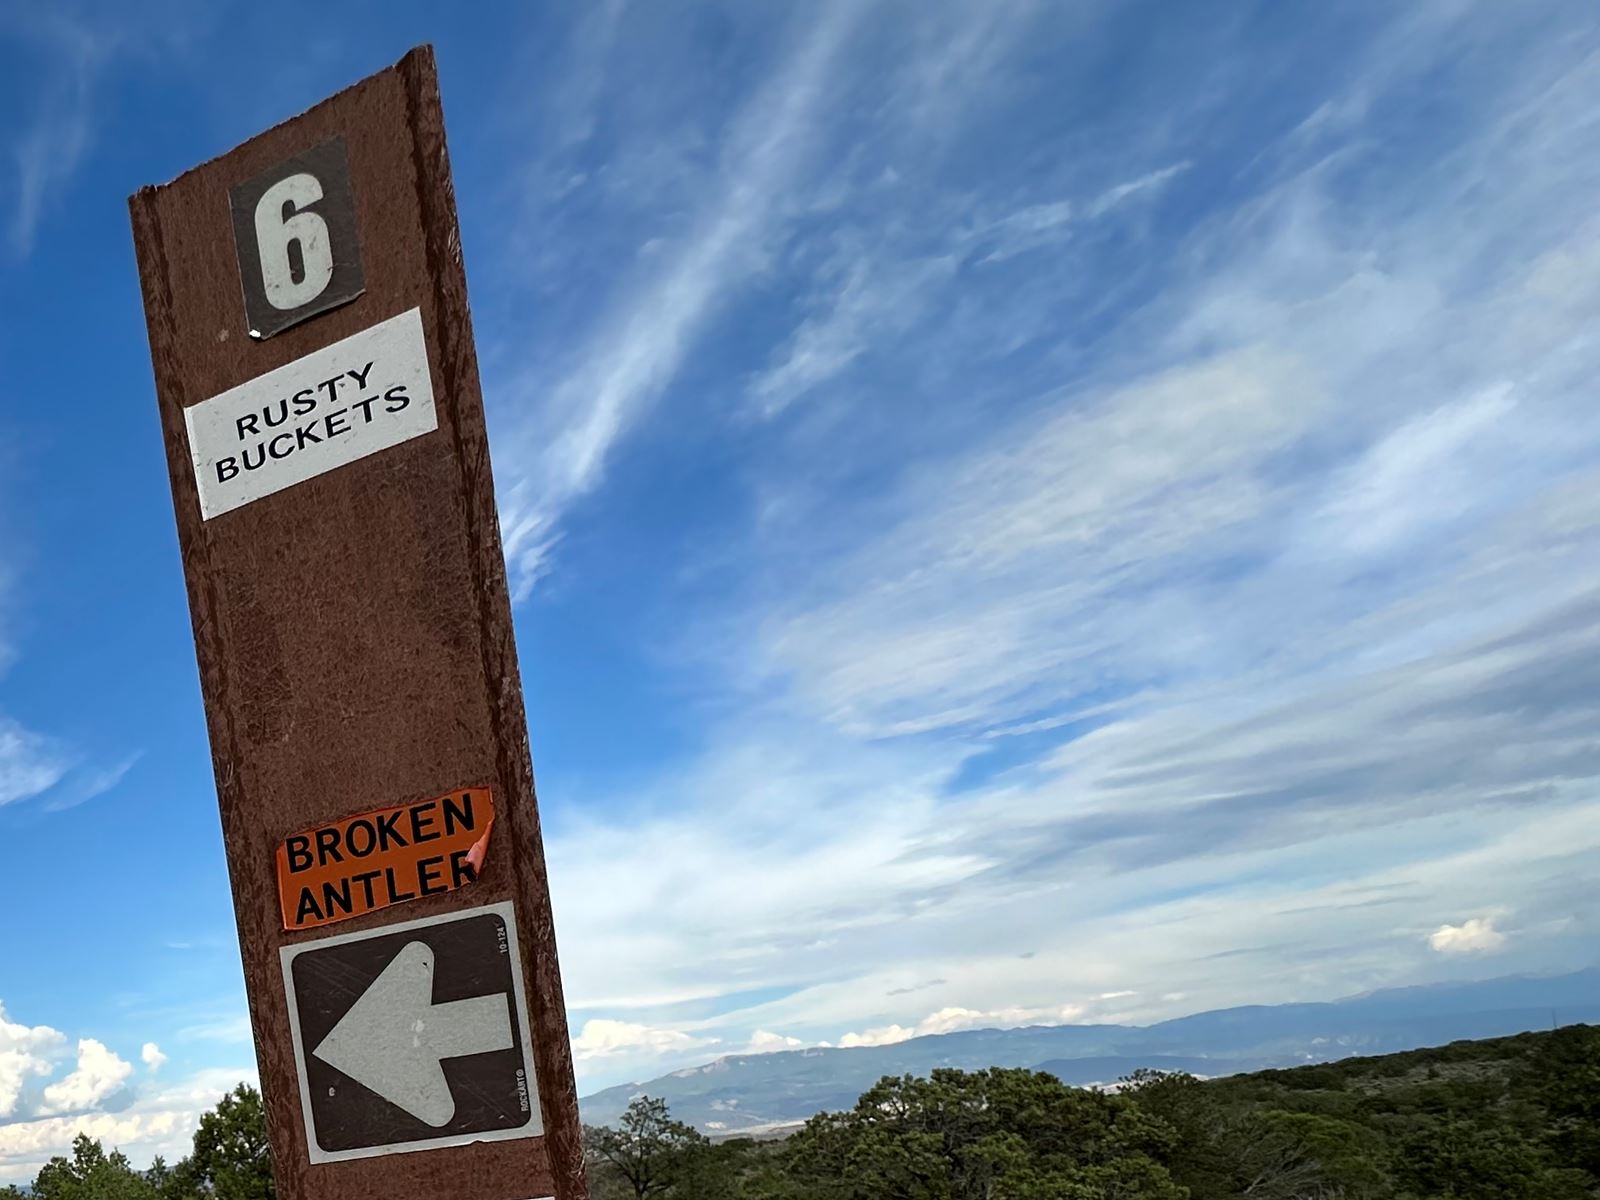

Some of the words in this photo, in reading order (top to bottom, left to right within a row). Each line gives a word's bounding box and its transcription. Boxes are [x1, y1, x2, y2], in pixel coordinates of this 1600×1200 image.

[254, 173, 334, 310] 6
[215, 385, 411, 485] BUCKETS
[237, 361, 375, 441] RUSTY
[285, 793, 475, 874] BROKEN
[296, 853, 478, 924] ANTLER
